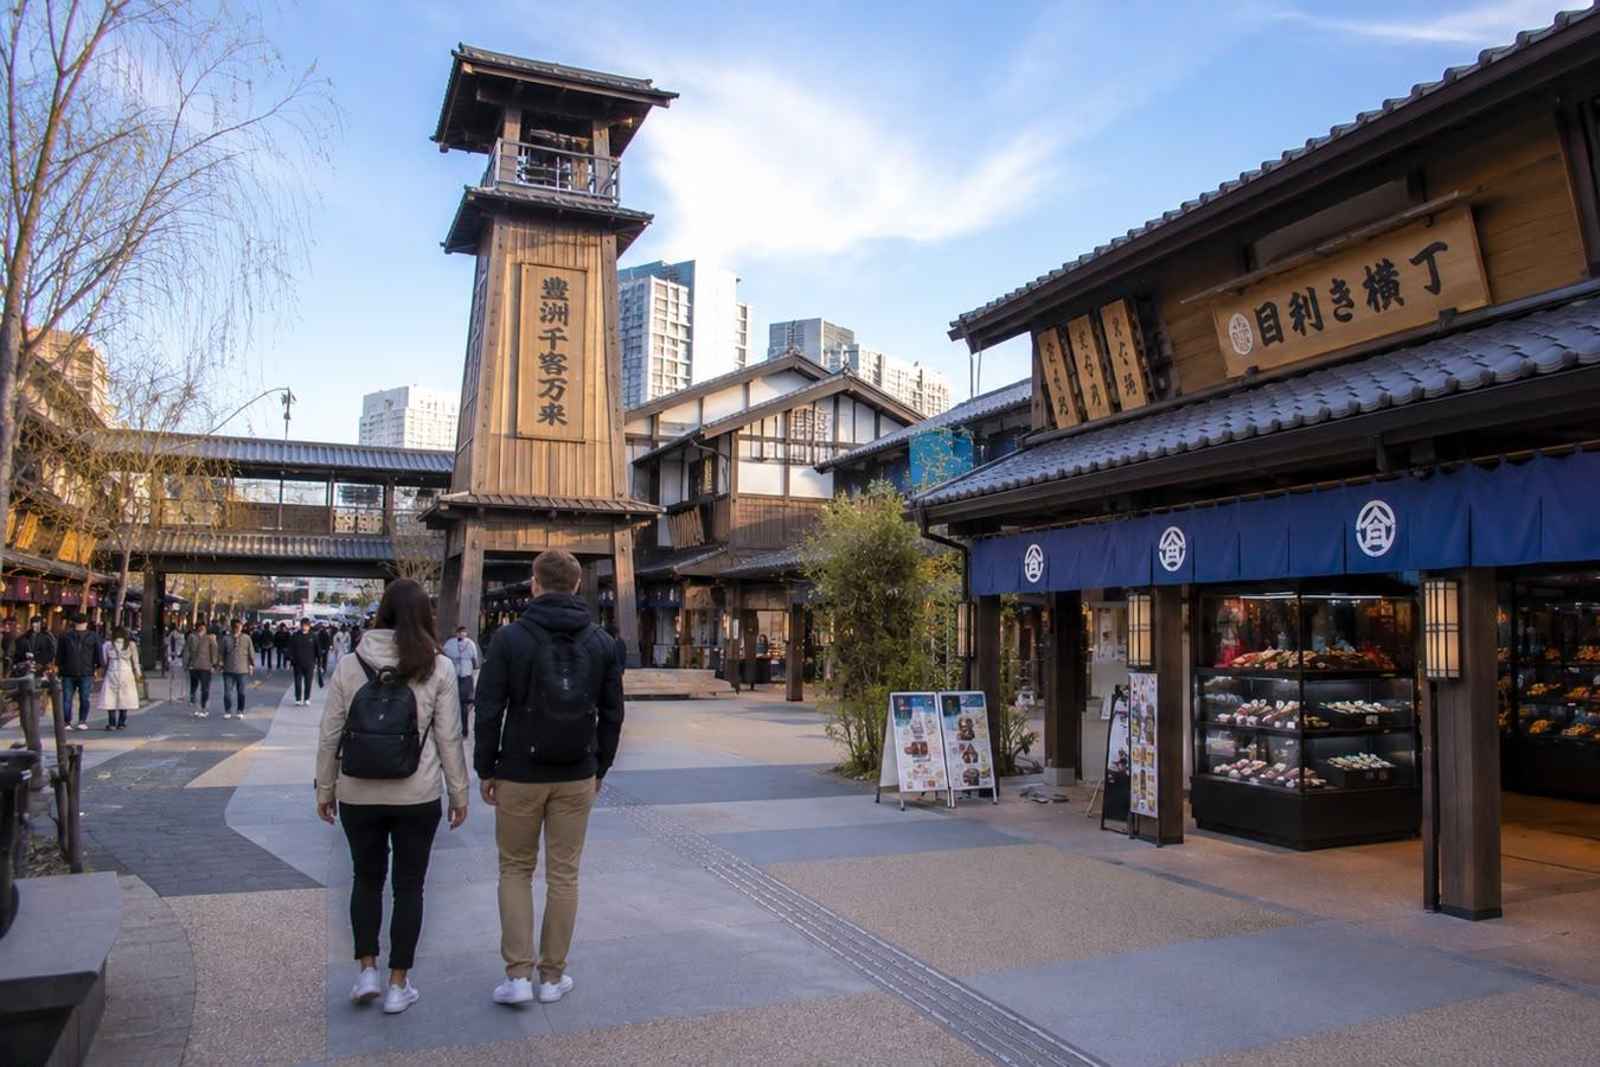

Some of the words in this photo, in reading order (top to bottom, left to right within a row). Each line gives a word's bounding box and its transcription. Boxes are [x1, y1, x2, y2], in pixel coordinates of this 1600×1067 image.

[1256, 241, 1448, 346] 目利き横丁
